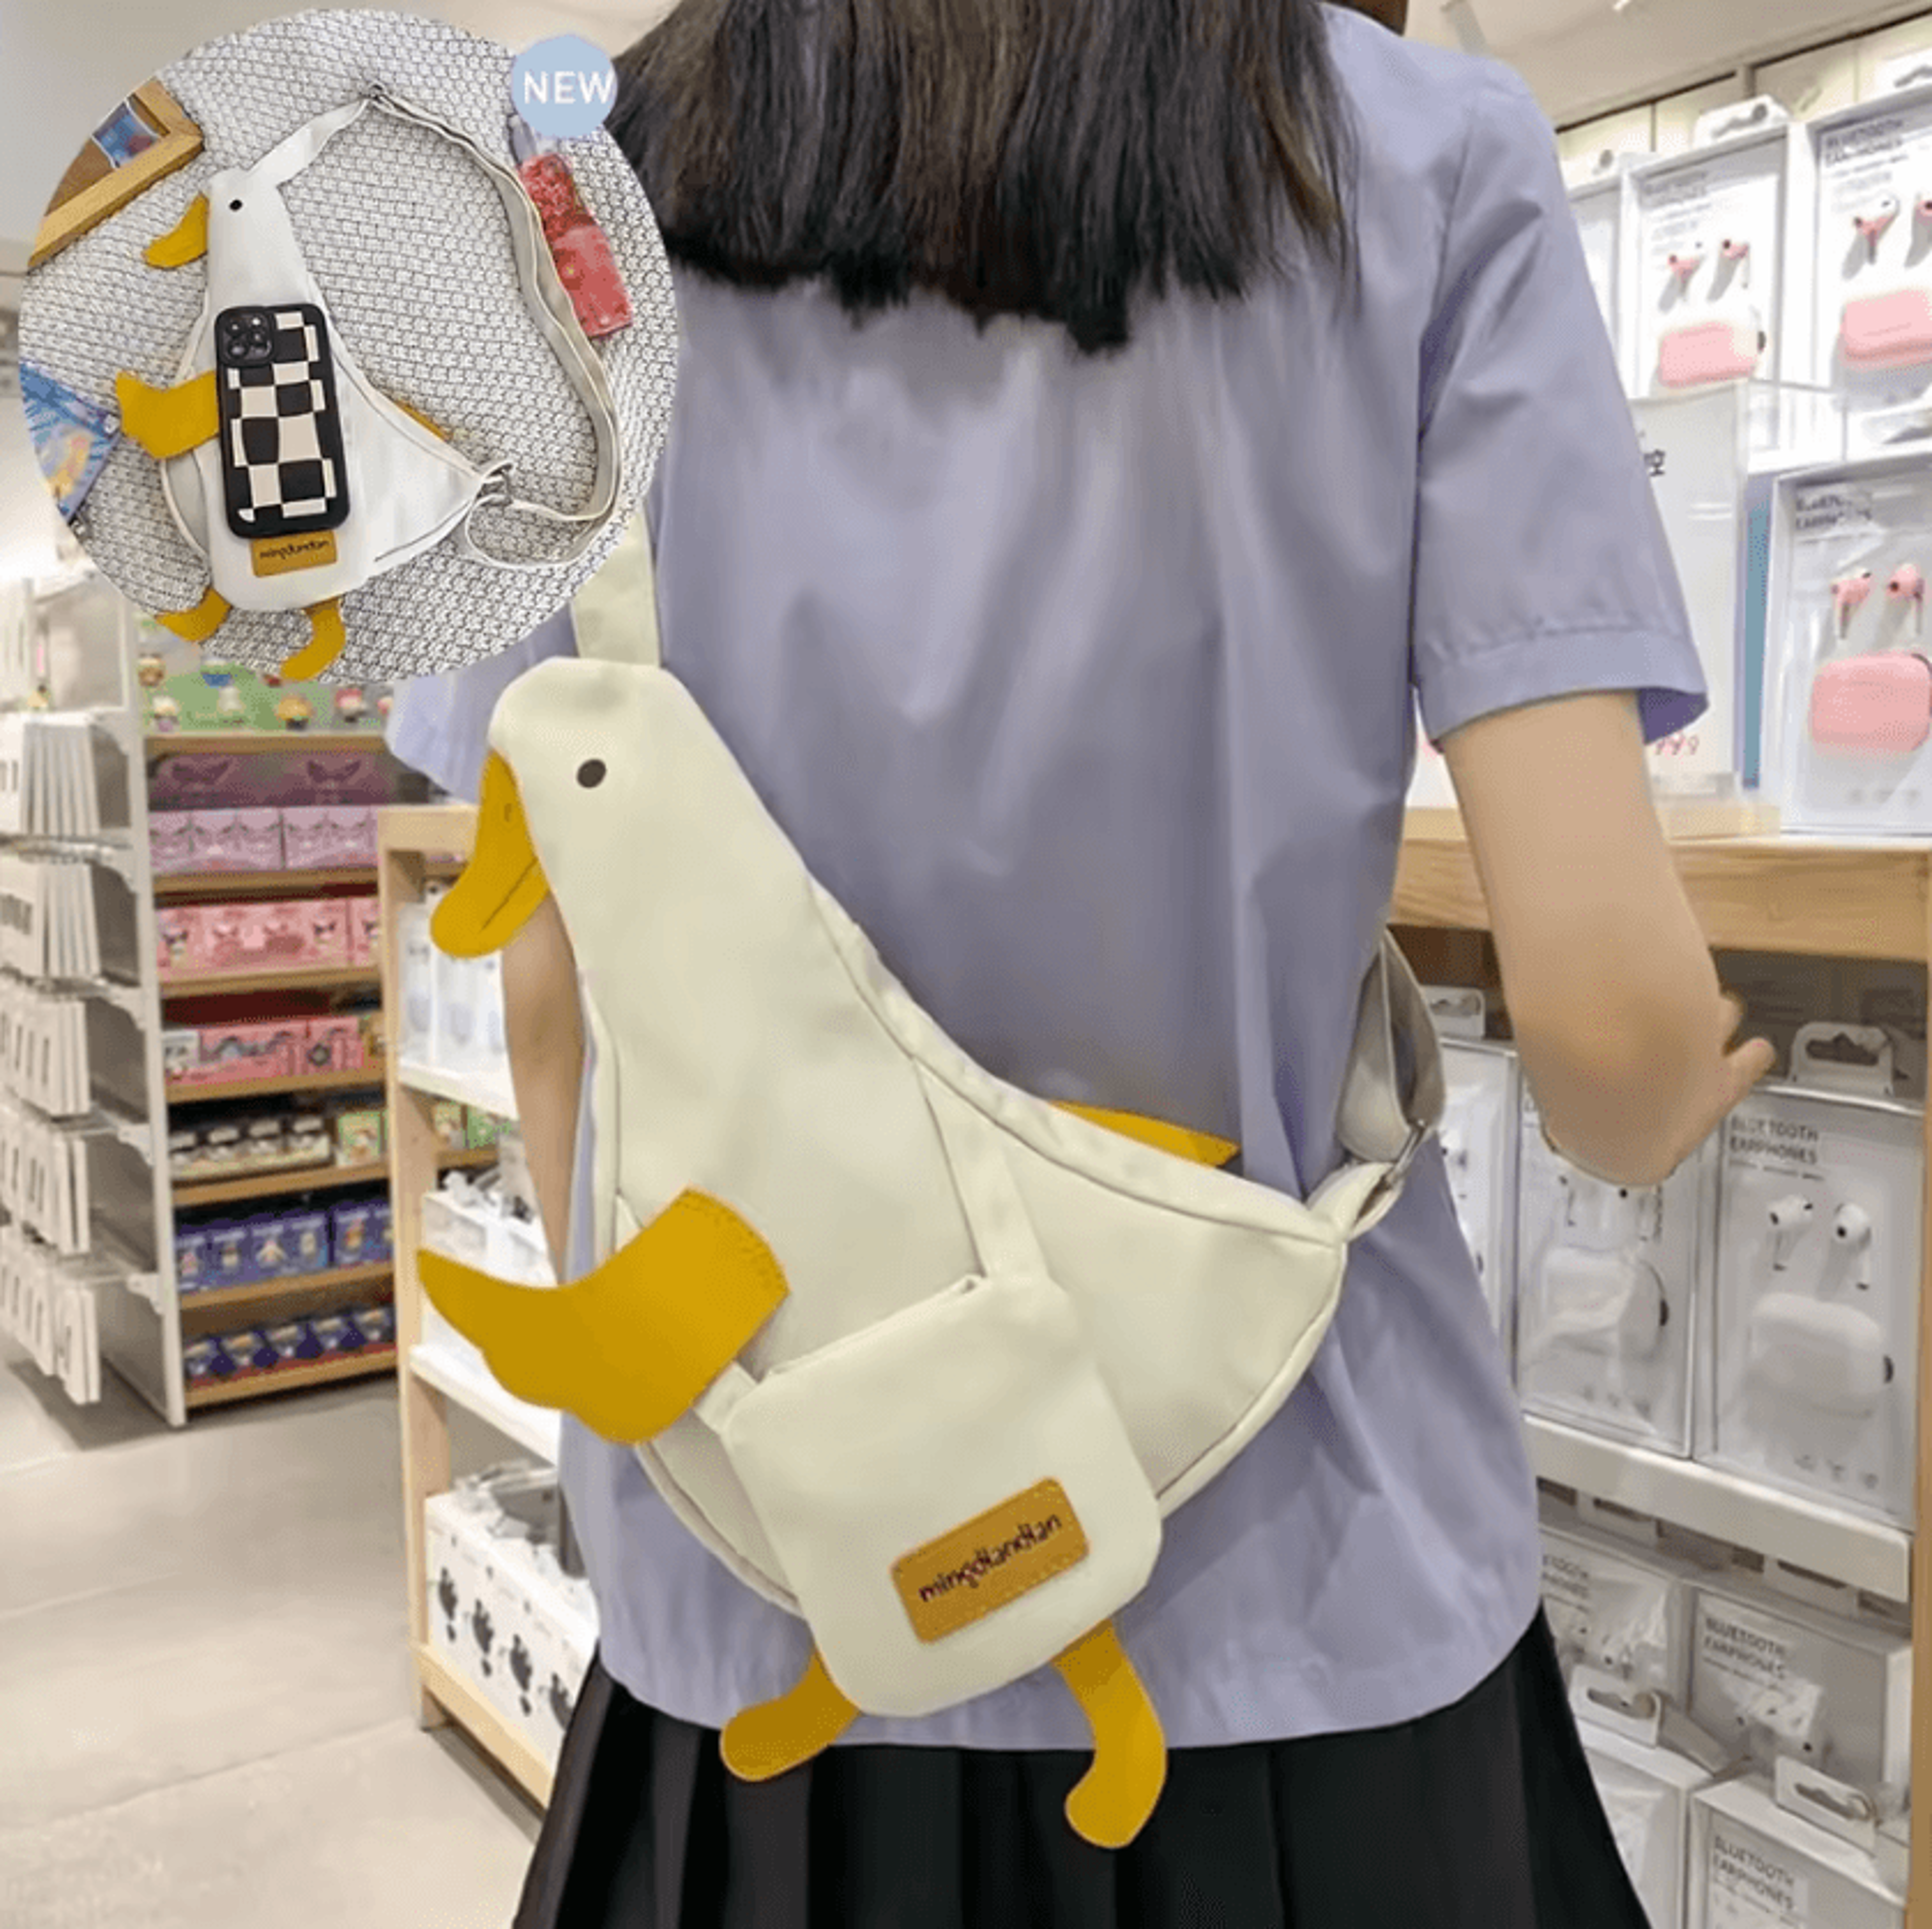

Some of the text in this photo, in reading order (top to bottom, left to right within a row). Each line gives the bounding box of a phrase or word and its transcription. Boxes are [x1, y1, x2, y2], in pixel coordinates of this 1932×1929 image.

[1730, 1115, 1819, 1142] BLUETOOTH
[1730, 1135, 1818, 1165] EARPHONES
[1706, 1617, 1785, 1656] BLUETOOTH
[1704, 1636, 1786, 1681] EARPHONES
[1713, 1854, 1794, 1910] EARPHONES
[1715, 1836, 1795, 1887] BLUETOOTH
